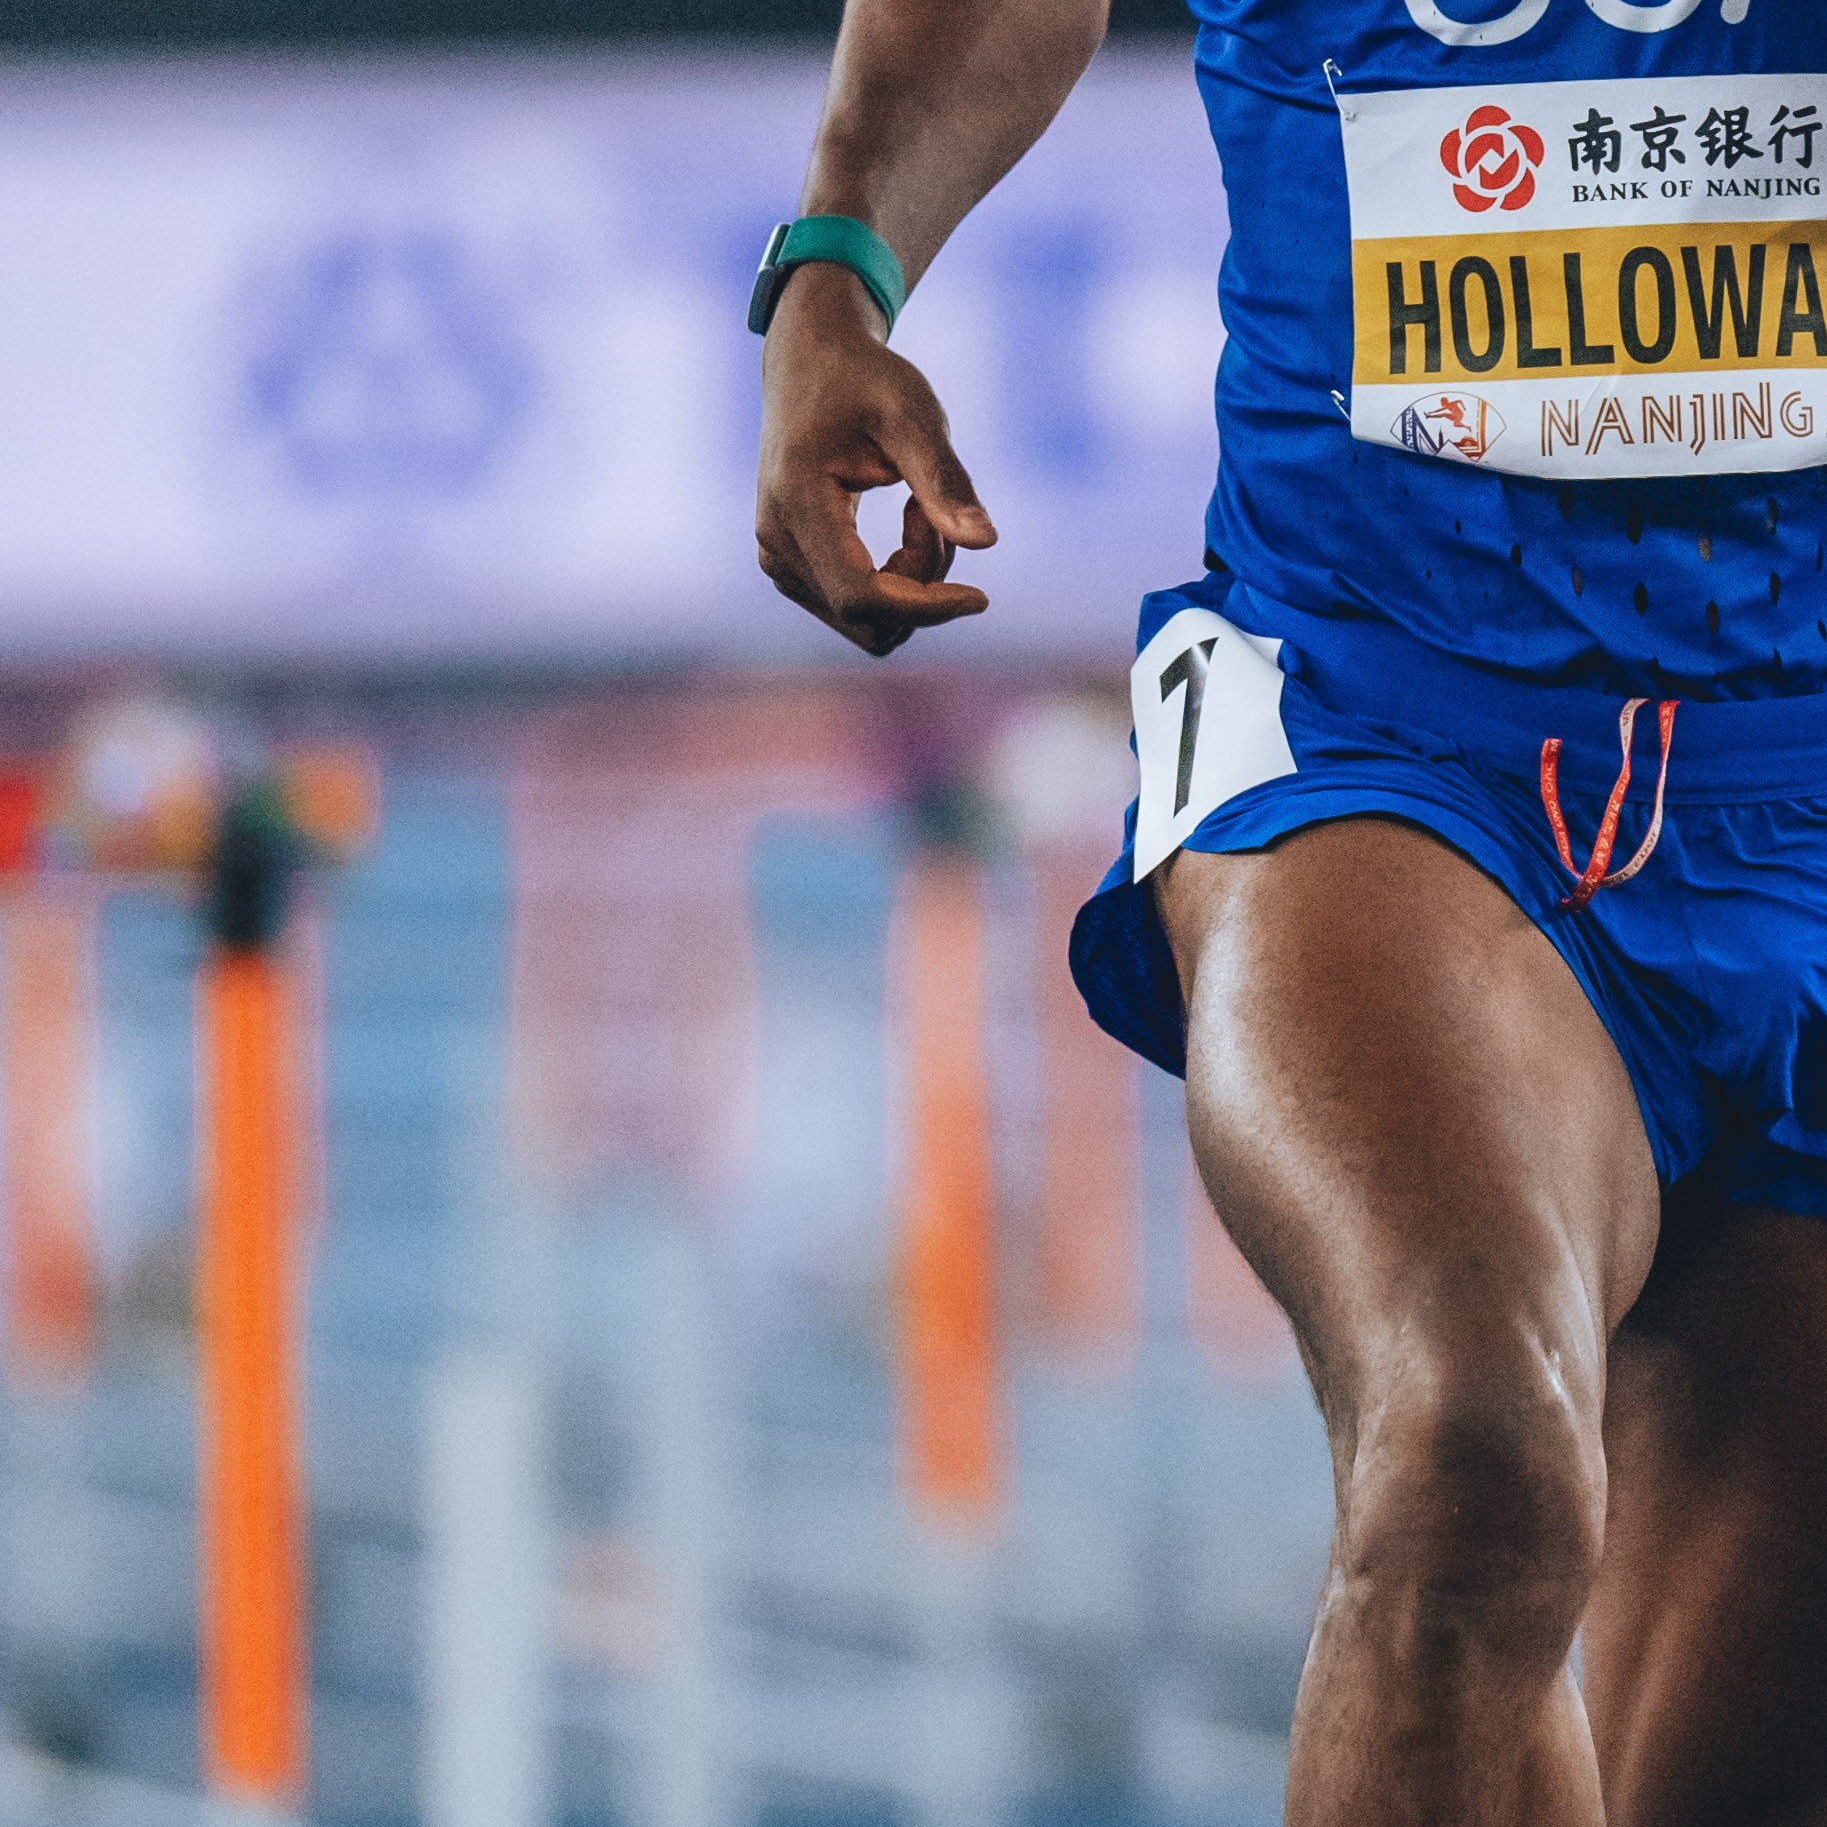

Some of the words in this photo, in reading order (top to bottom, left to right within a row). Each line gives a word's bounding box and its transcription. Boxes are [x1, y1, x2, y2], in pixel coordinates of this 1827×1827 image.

[1567, 104, 1823, 176] 南京银行
[1572, 180, 1649, 203] BANK
[1660, 179, 1693, 199] OF
[1706, 176, 1821, 200] NANJING
[1539, 381, 1815, 458] NANJING
